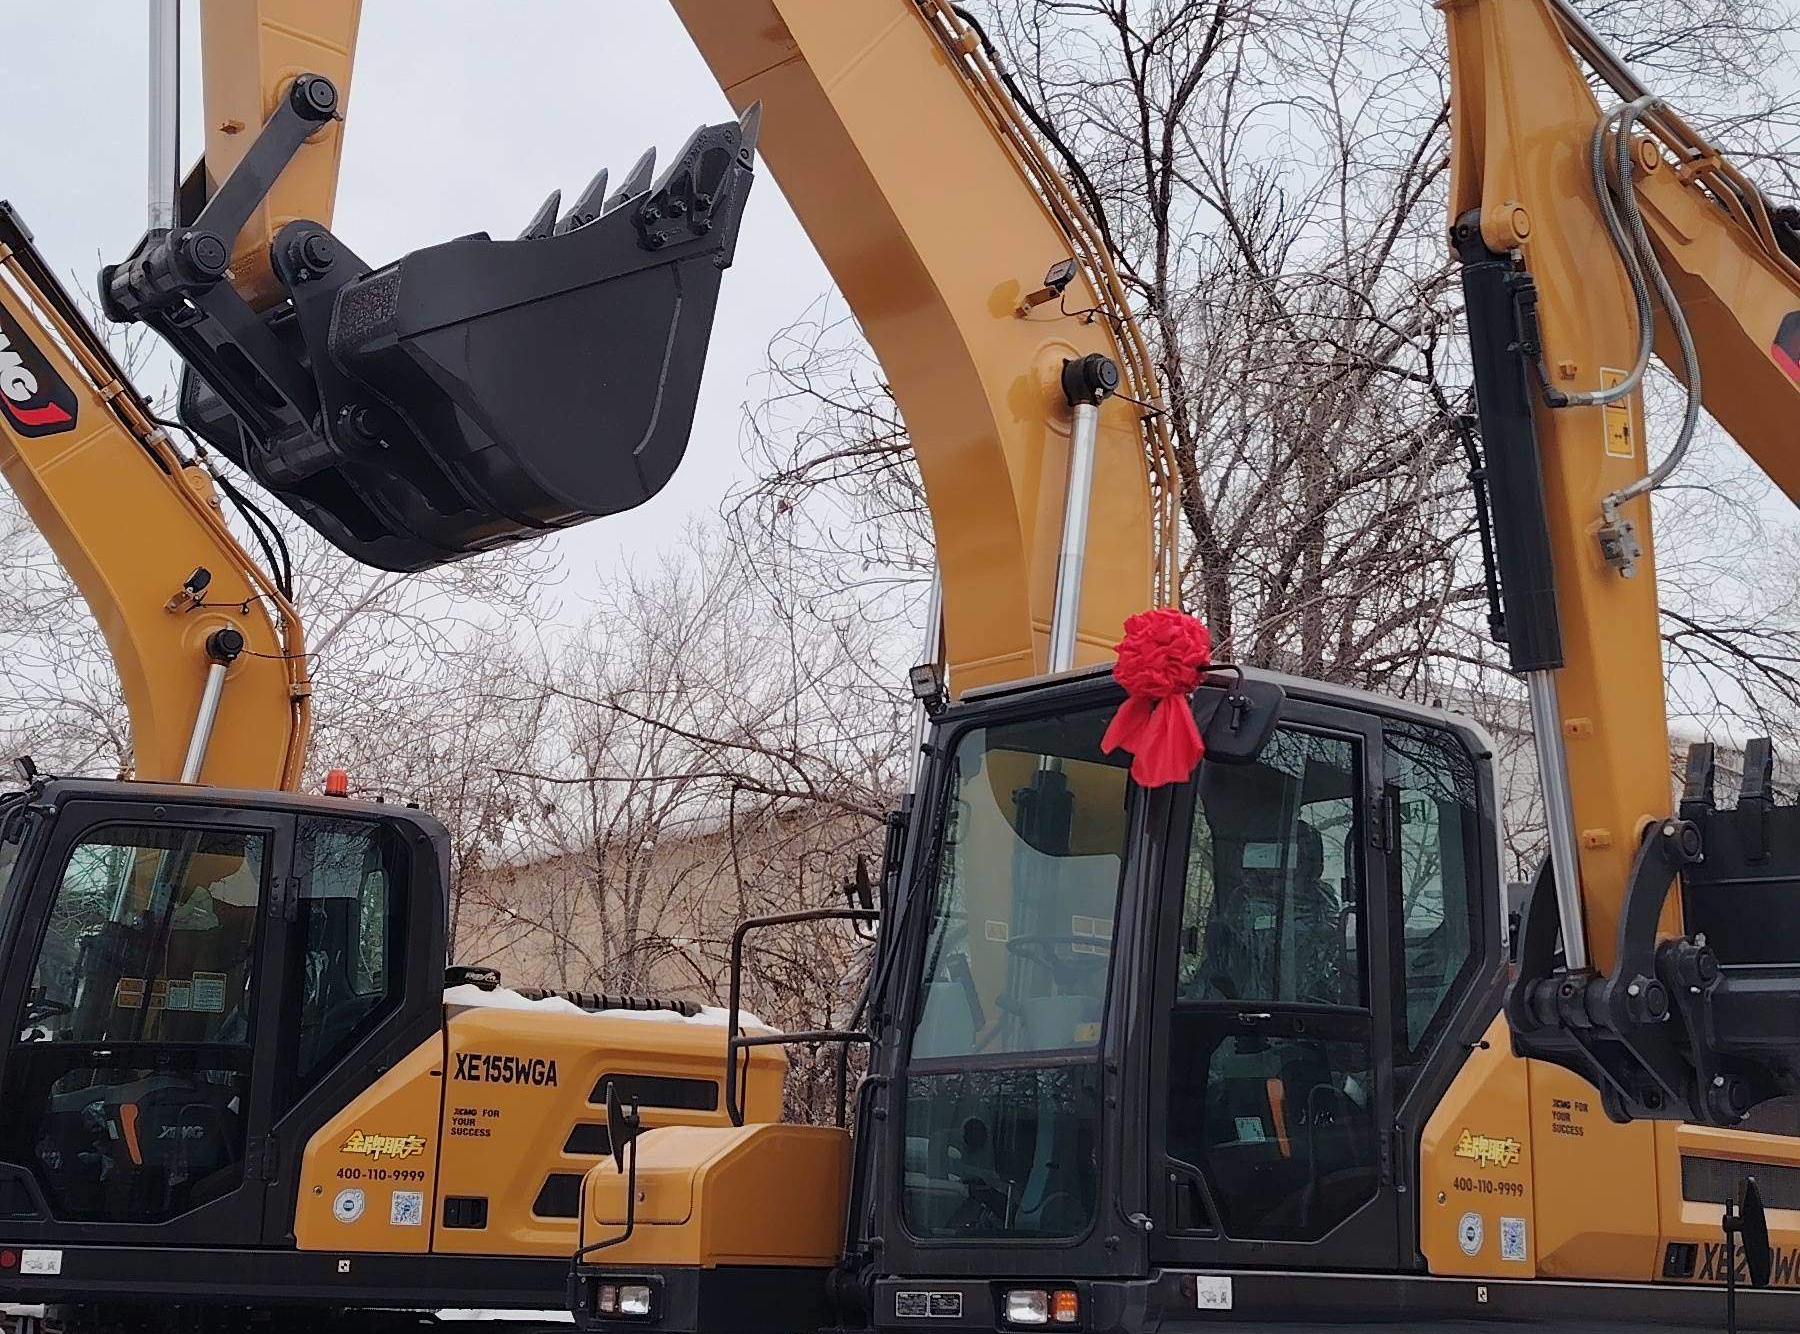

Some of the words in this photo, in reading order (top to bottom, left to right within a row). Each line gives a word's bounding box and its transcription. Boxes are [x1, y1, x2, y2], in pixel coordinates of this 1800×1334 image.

[454, 1053, 557, 1087] XE155WGA
[482, 1109, 499, 1117] FOR
[1575, 1101, 1588, 1113] FOR
[452, 1117, 475, 1126] YOUR
[1552, 1110, 1571, 1122] YOUR
[451, 1127, 491, 1137] SUCCESS
[1552, 1123, 1584, 1136] SUCCESS
[340, 1129, 427, 1161] 金牌服务
[1455, 1128, 1521, 1167] 金牌服务
[337, 1168, 425, 1181] 400-110-9999
[1453, 1176, 1524, 1197] 400-110-9999
